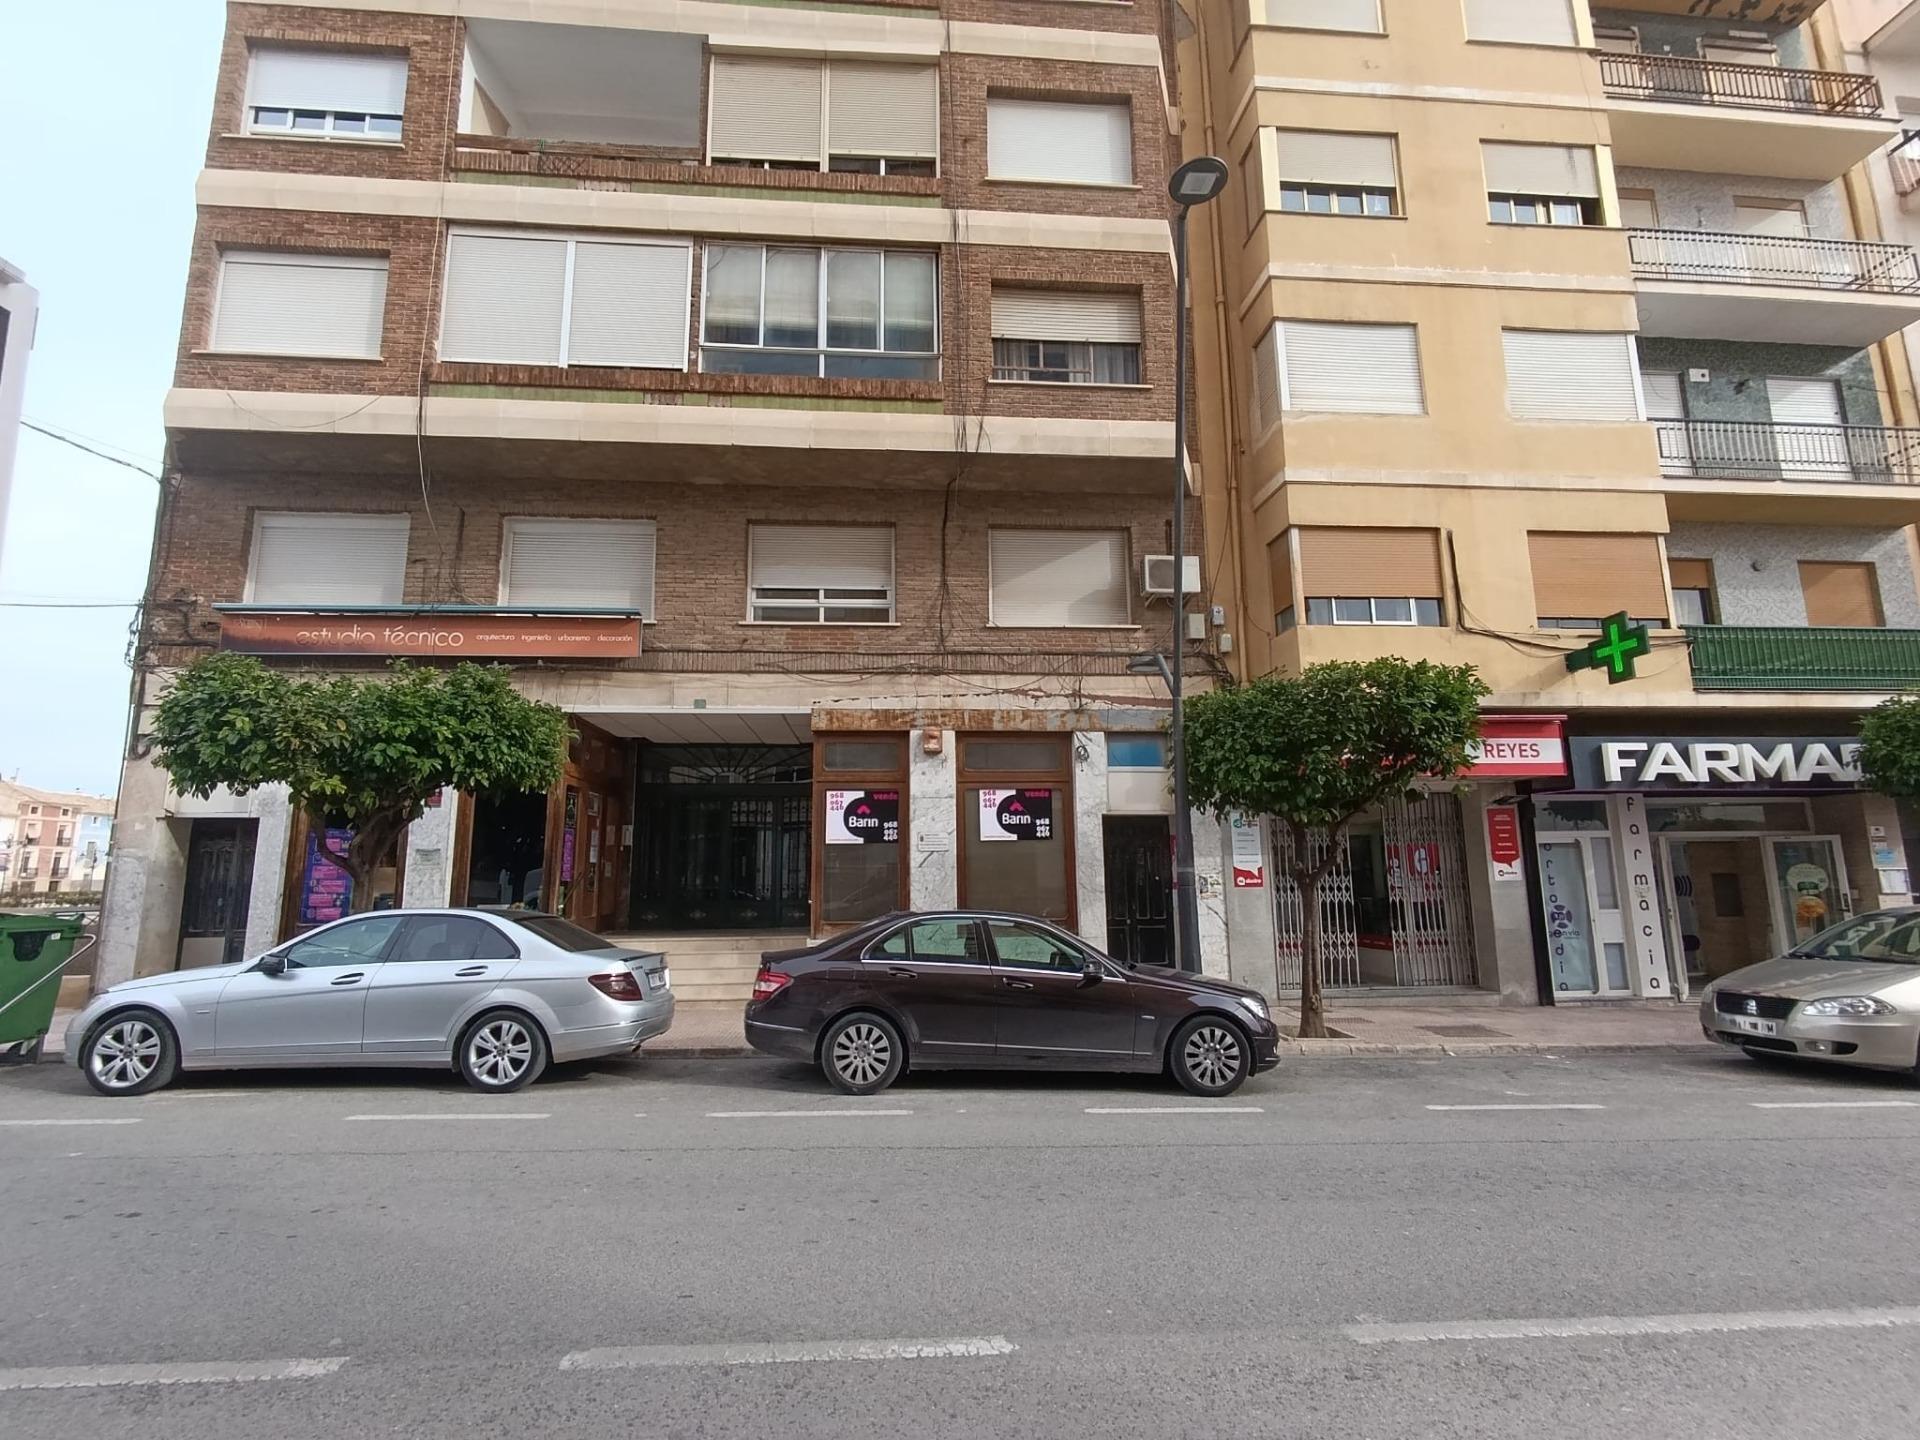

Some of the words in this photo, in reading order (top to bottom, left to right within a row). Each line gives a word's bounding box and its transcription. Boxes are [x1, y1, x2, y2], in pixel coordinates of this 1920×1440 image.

[296, 623, 375, 646] estudio
[383, 625, 464, 647] técnico
[476, 633, 515, 642] arquitectura
[557, 633, 591, 642] urbanismo
[597, 633, 633, 642] decoración
[1484, 743, 1540, 758] REYES
[883, 821, 898, 829] 968
[1626, 797, 1661, 989] farmacia
[1543, 843, 1569, 991] ortomedia
